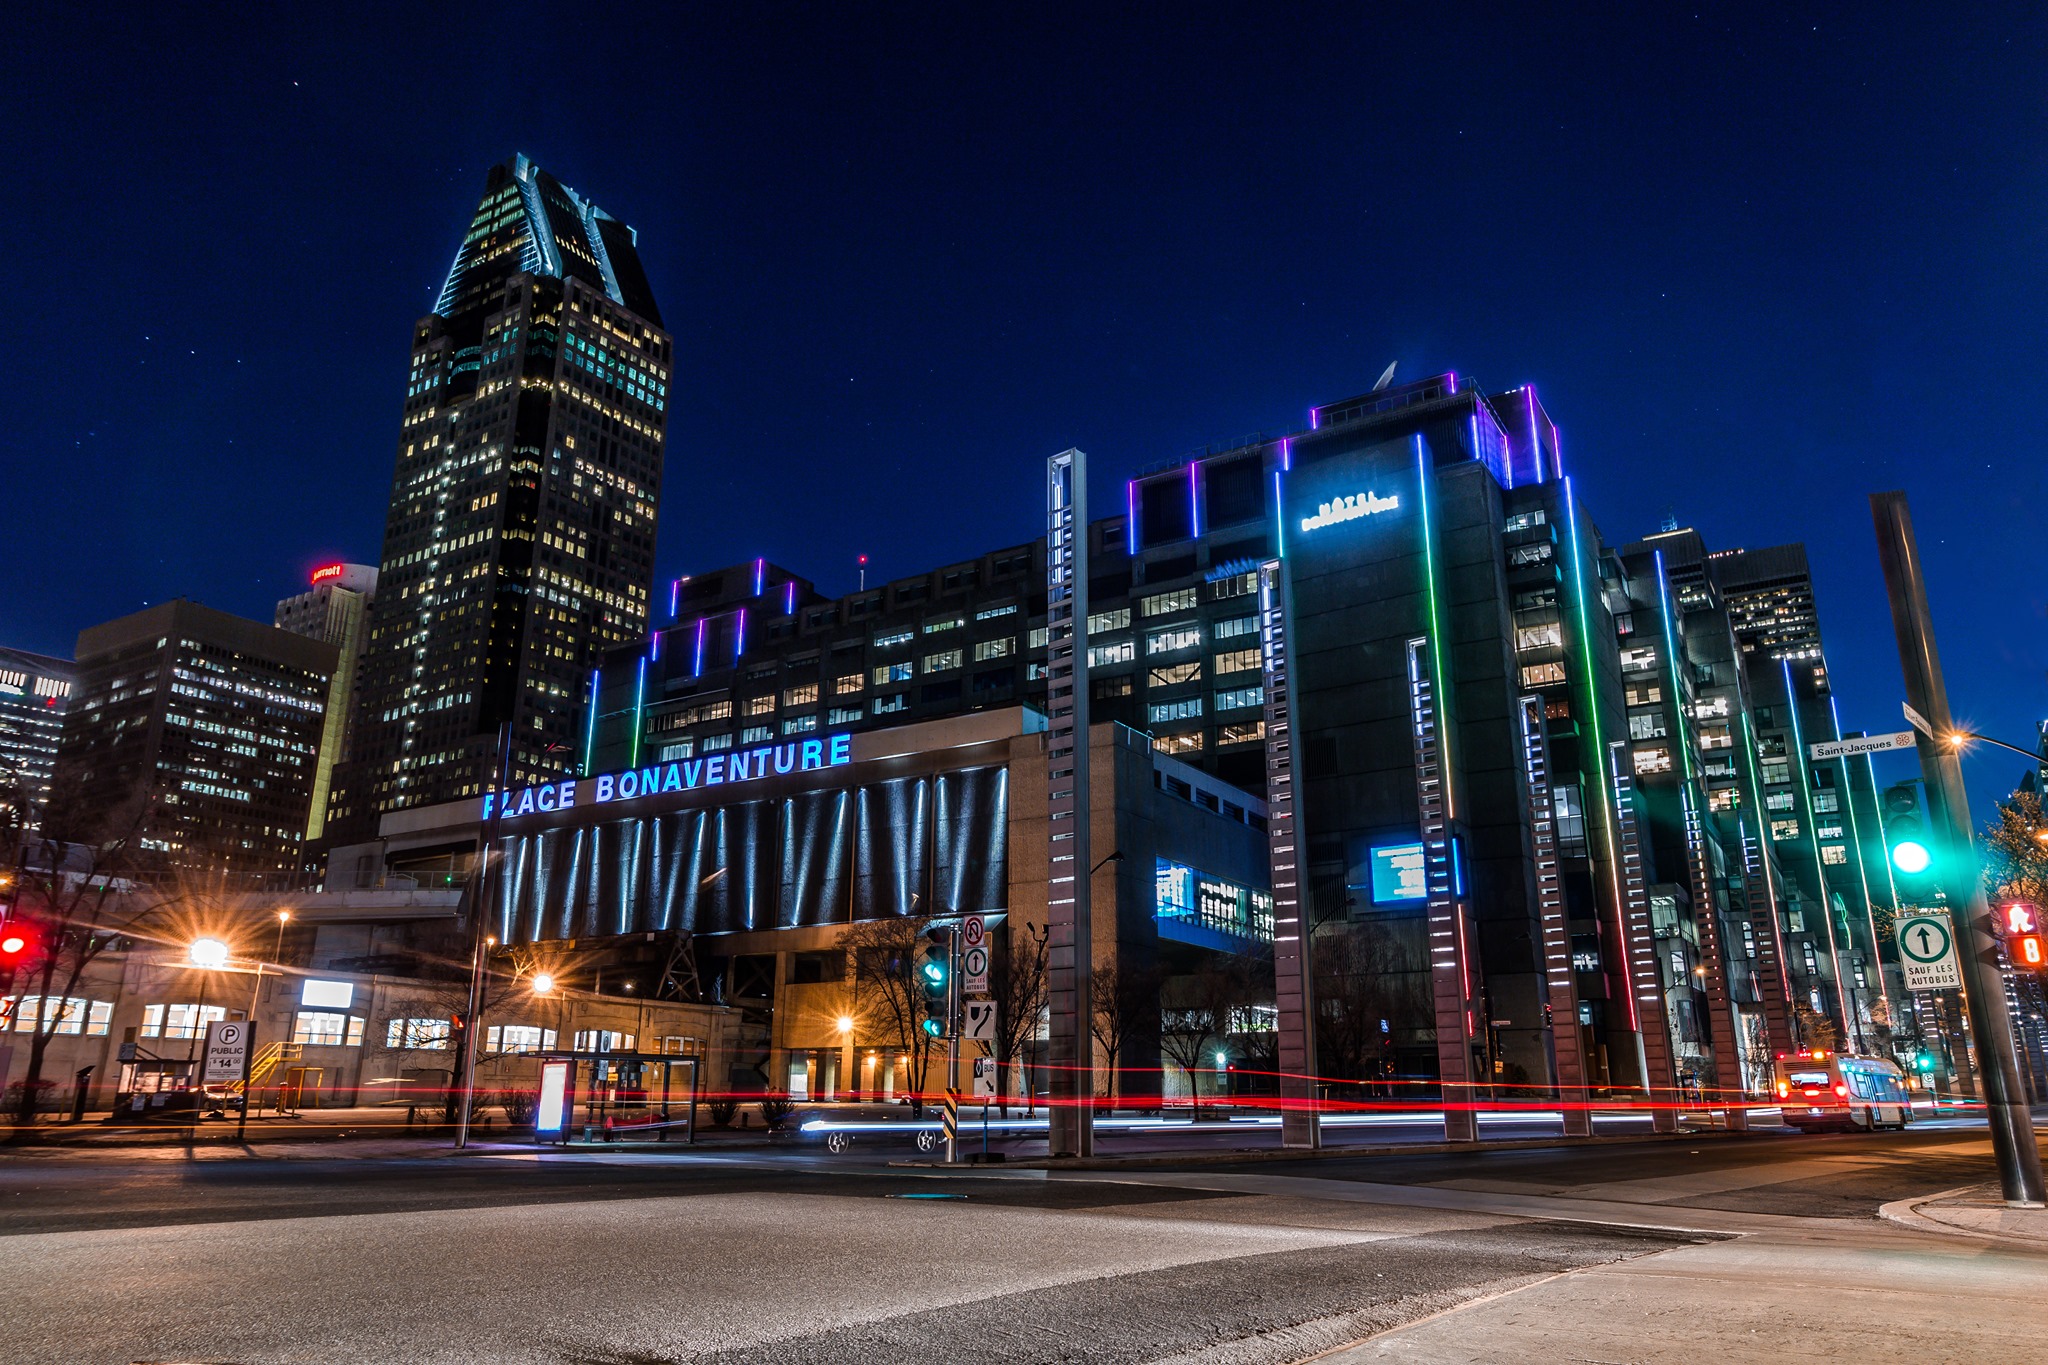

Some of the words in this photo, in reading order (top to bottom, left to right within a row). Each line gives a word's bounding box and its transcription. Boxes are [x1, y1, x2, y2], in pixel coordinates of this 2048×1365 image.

[1817, 742, 1892, 757] Saint-Jacques
[596, 733, 851, 803] BONAVENTURE
[1908, 966, 1932, 976] SAUF
[1936, 964, 1953, 973] LES
[1911, 974, 1956, 986] AUTOBUS
[224, 1029, 236, 1041] P
[210, 1047, 244, 1055] PUBLIC
[984, 1063, 994, 1073] BUS
